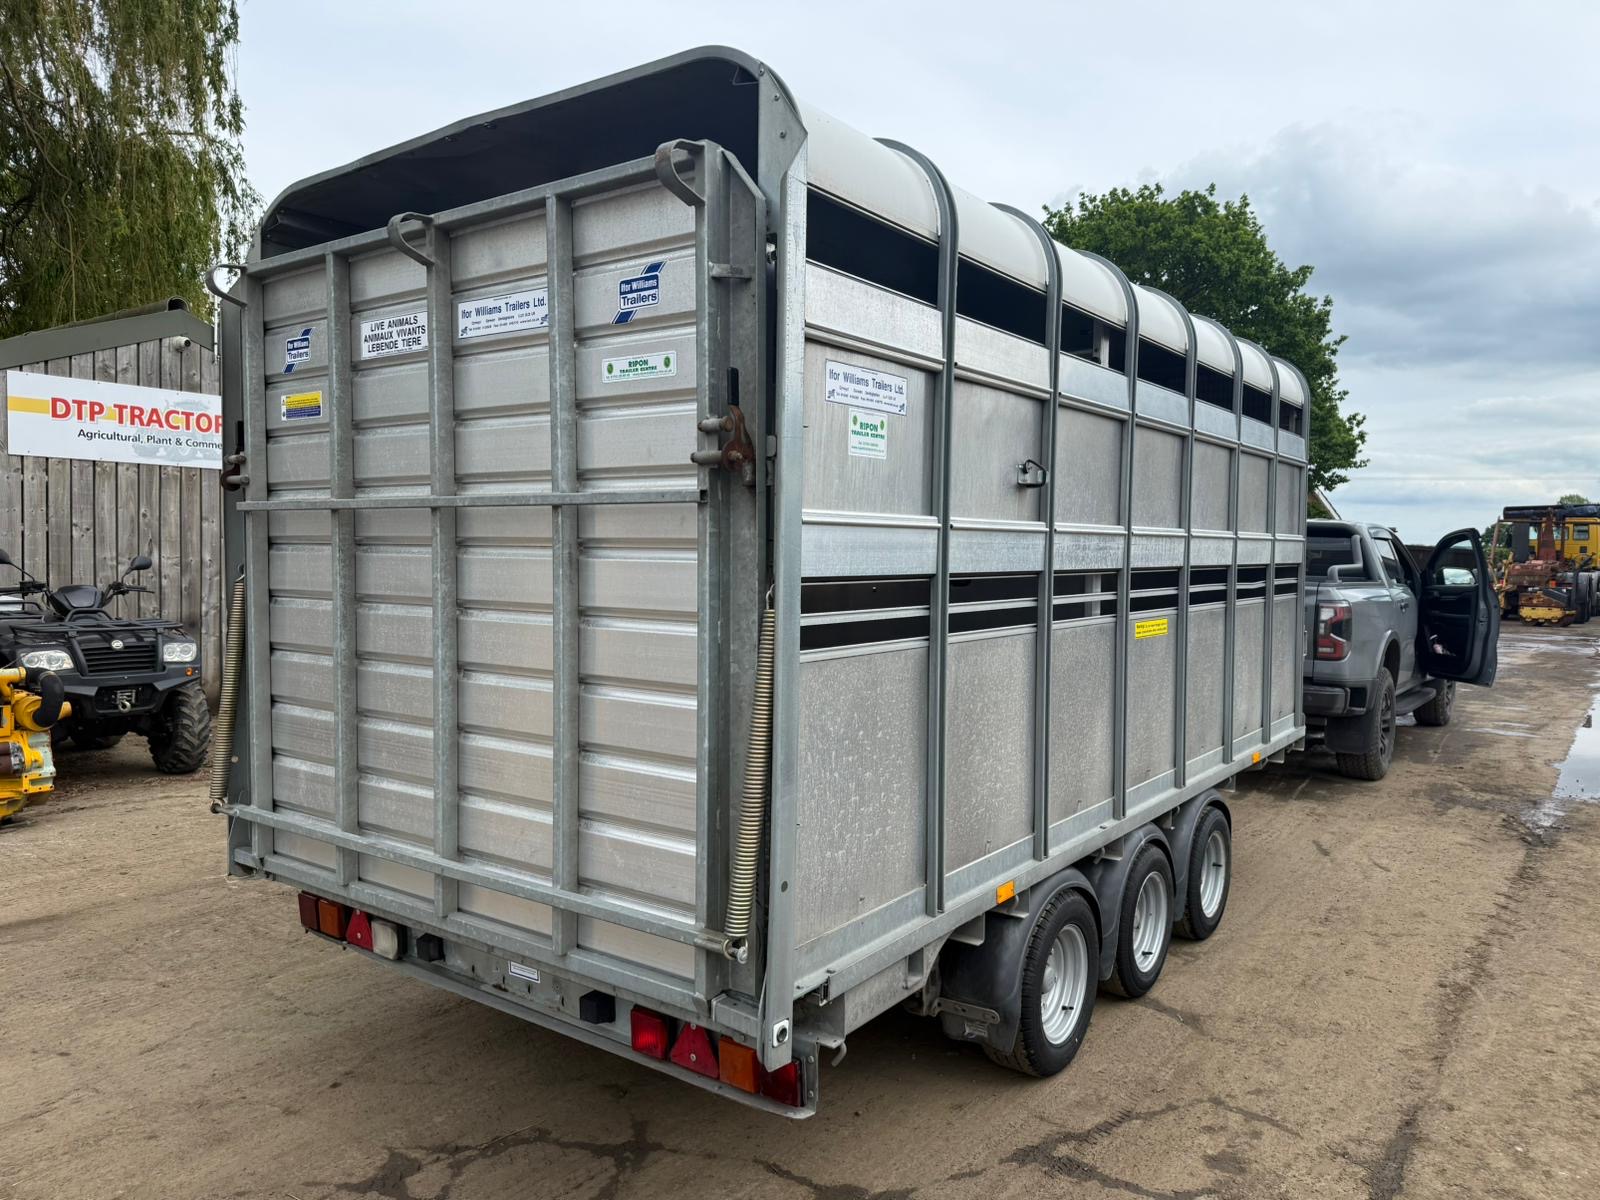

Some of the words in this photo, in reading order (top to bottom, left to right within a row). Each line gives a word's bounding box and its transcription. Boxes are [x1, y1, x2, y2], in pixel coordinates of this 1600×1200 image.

[620, 282, 631, 292] Ifor
[631, 279, 657, 291] Williams
[461, 309, 472, 319] Ifor
[475, 305, 502, 317] Williams
[505, 300, 530, 312] Trailers
[533, 296, 546, 308] Ltd.
[621, 292, 657, 306] Trailers
[371, 321, 385, 332] LIVE
[387, 315, 418, 329] ANIMALS
[364, 331, 393, 343] ANIMAUX
[396, 325, 426, 338] VIVANTS
[368, 340, 399, 353] LEBENDE
[402, 336, 421, 348] TIERE
[628, 359, 649, 367] RIPON
[829, 368, 840, 380] Ifor
[843, 371, 869, 387] Williams
[871, 377, 893, 392] Trailers
[51, 397, 105, 422] DTP
[860, 422, 879, 432] RIPON
[78, 429, 144, 445] Agricultural,
[147, 435, 172, 446] Plant
[175, 437, 183, 446] &
